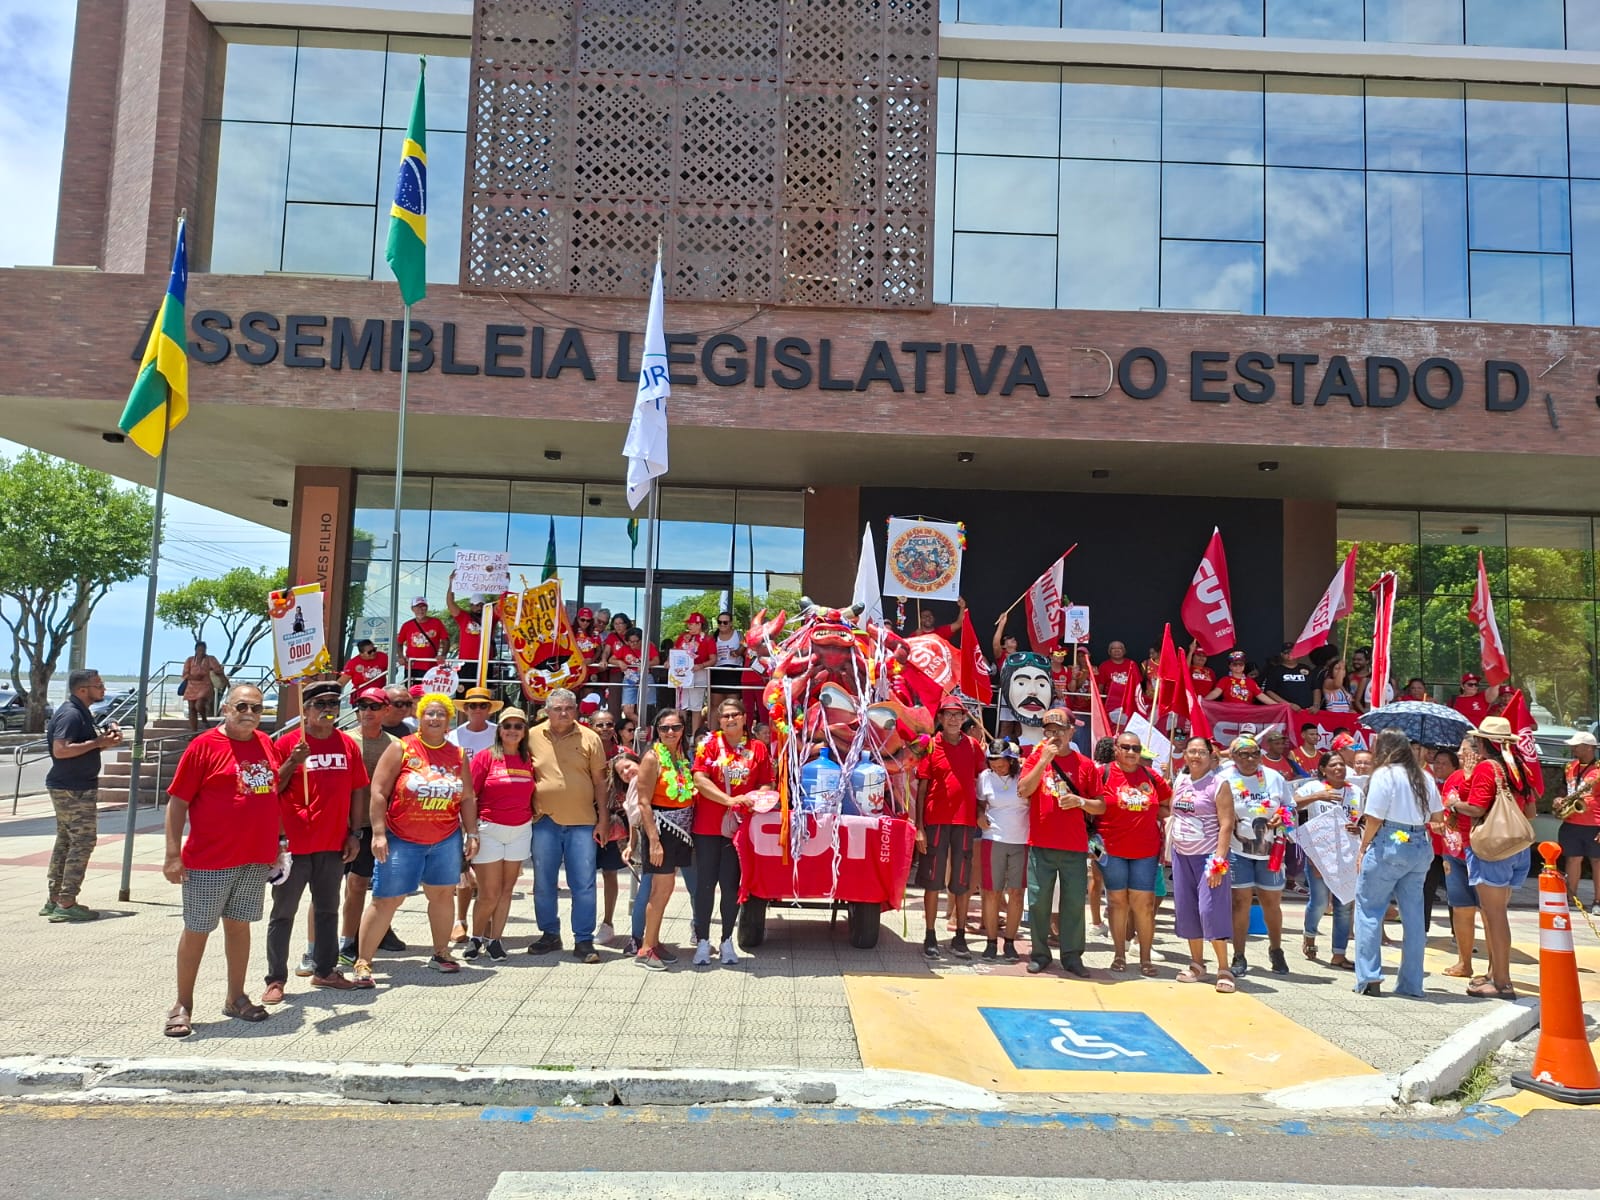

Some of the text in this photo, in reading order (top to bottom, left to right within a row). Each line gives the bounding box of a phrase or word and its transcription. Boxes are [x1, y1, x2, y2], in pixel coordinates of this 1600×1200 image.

[616, 330, 1050, 397] LEGISLATIVA
[1190, 350, 1464, 410] ESTADO
[319, 513, 332, 552] FILHO
[1192, 557, 1232, 625] CUT
[290, 642, 311, 660] ÓDIO
[305, 754, 345, 768] CUT
[249, 777, 269, 787] SIRI
[417, 785, 454, 799] SIRI
[749, 811, 879, 860] CUT
[880, 816, 892, 863] SERGIPE
